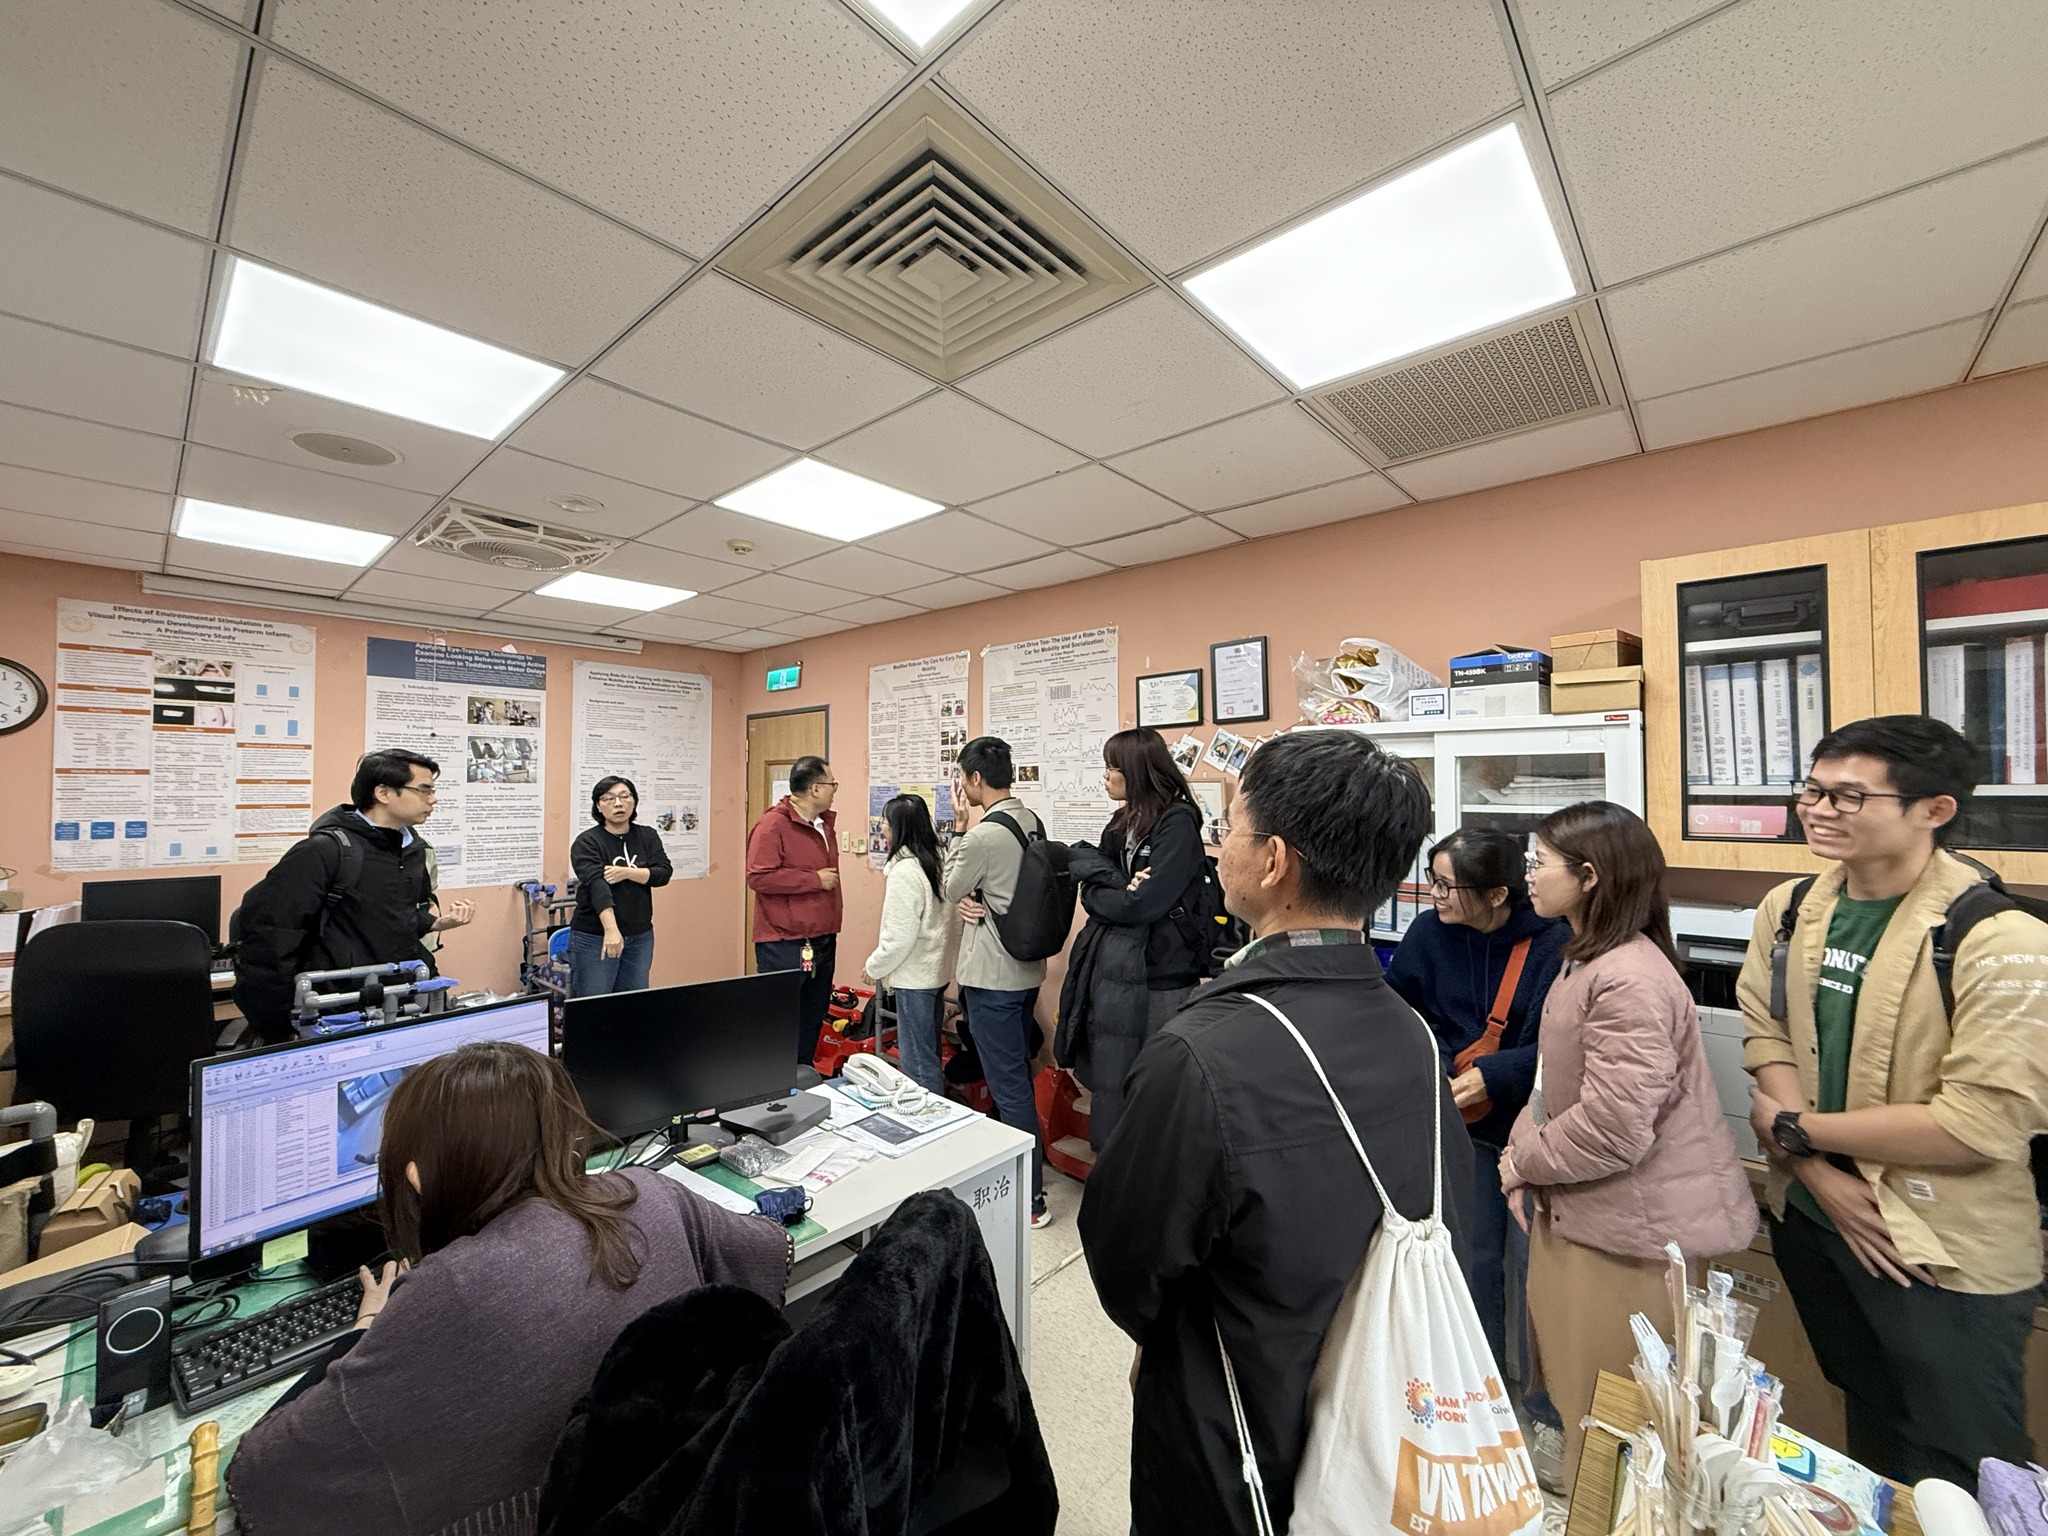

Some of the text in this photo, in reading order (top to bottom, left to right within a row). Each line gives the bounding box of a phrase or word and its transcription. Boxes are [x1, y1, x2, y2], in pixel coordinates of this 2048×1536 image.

[87, 611, 116, 620] Visual
[118, 614, 164, 625] Perception
[167, 620, 222, 631] Development
[233, 627, 264, 636] Preterm
[113, 605, 142, 615] Effects
[155, 611, 216, 622] Environmental
[218, 617, 262, 628] Stimulation
[165, 628, 212, 639] Preliminary
[214, 633, 236, 641] Study
[415, 642, 446, 652] Applying
[447, 646, 489, 656] Eye-Tracking
[491, 650, 525, 660] Technology
[1041, 645, 1060, 653] Mobility
[1071, 638, 1104, 648] Socialization
[446, 653, 473, 661] Looking
[474, 656, 505, 664] Behaviors
[1507, 652, 1533, 660] brother
[415, 656, 456, 666] Locomotion
[465, 661, 492, 670] Toddlers
[526, 667, 546, 675] Delays
[2, 672, 7, 681] 1
[14, 681, 23, 690] 2
[20, 693, 28, 703] 3
[14, 705, 22, 714] 4
[0, 713, 8, 723] 5
[1776, 718, 1791, 759] 個案資料
[1714, 736, 1727, 775] 個案資料
[1741, 736, 1755, 776] 個案資料
[2002, 953, 2034, 964] NEW
[973, 1175, 1010, 1210] 职治
